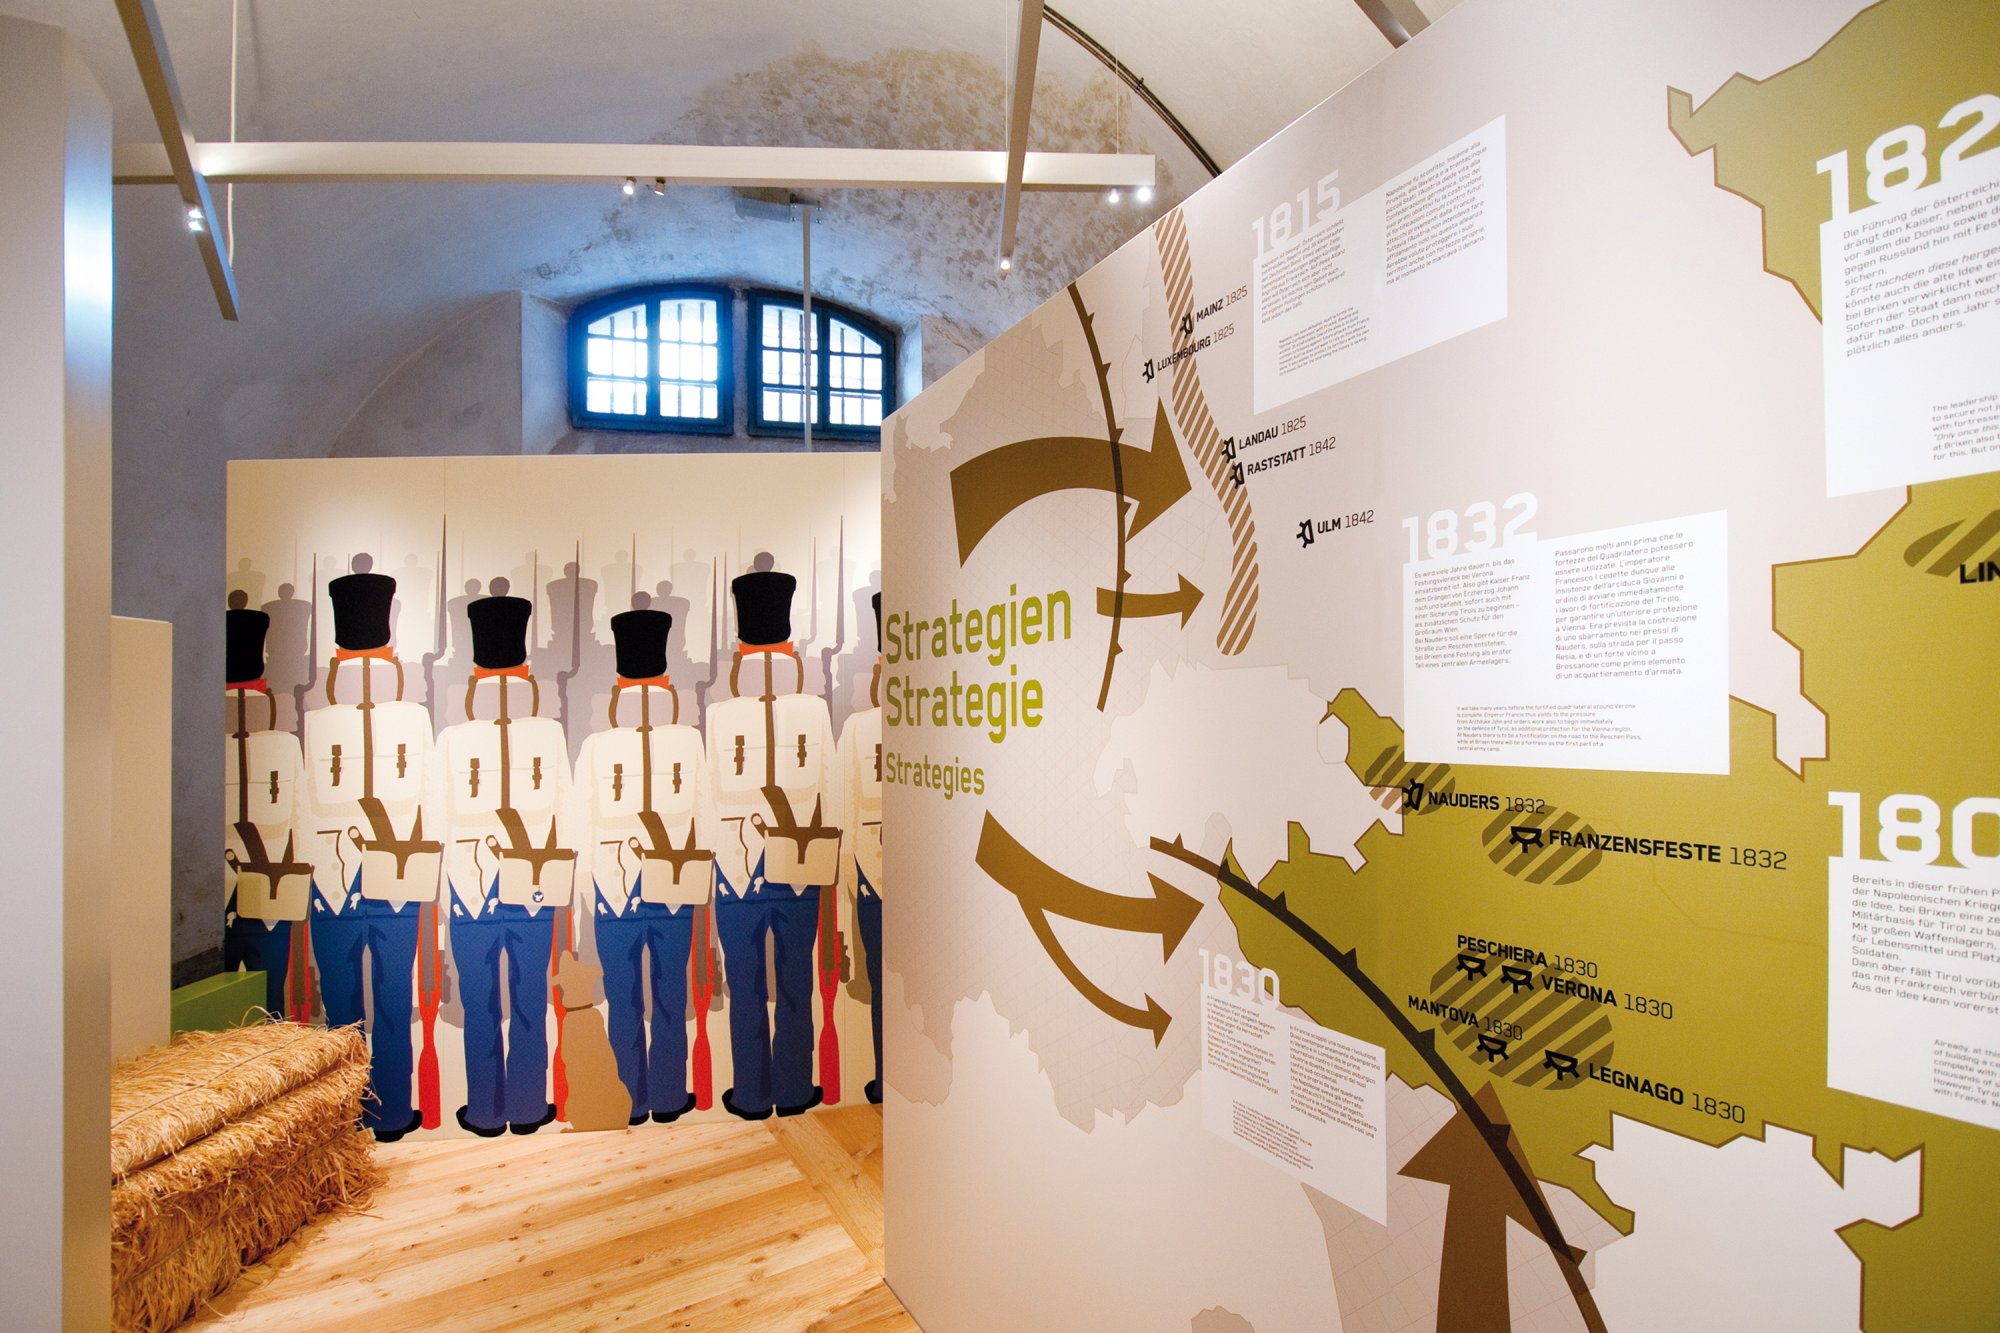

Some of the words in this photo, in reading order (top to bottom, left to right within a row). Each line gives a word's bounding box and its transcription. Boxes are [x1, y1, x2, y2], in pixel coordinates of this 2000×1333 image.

[1816, 93, 2000, 222] 182
[1252, 169, 1340, 259] 1815
[1843, 228, 1859, 240] Die
[1862, 212, 1907, 233] Führung
[1910, 204, 1930, 216] der
[1843, 232, 1879, 251] drängt
[1882, 226, 1902, 238] den
[1905, 213, 1943, 230] Kaiser,
[1946, 199, 1982, 217] neben
[1843, 251, 1862, 263] vor
[1863, 241, 1892, 256] allem
[1894, 236, 1911, 246] die
[1913, 223, 1950, 240] Donau
[1952, 210, 1988, 228] sowie
[1844, 259, 1876, 276] gegen
[1879, 240, 1930, 263] Russland
[1932, 235, 1950, 246] hin
[1952, 227, 1971, 240] mit
[1844, 268, 1887, 286] sichern.
[1845, 293, 1881, 309] könnte
[1883, 284, 1910, 298] auch
[1912, 279, 1930, 290] die
[1932, 272, 1955, 284] alte
[1957, 264, 1983, 277] Idee
[1875, 268, 1925, 289] nachdem
[1927, 258, 1959, 273] diese
[1197, 299, 1224, 323] MAINZ
[1226, 285, 1248, 307] 1825
[1845, 309, 1861, 321] bei
[1863, 300, 1899, 316] Brixen
[1901, 278, 1970, 305] verwirklicht
[1845, 317, 1883, 333] Sofern
[1885, 311, 1904, 322] der
[1907, 300, 1939, 316] Staat
[1942, 293, 1971, 307] dann
[1846, 331, 1875, 344] dafür
[1878, 323, 1907, 336] habe.
[1910, 313, 1939, 328] Doch
[1942, 308, 1960, 319] ein
[1963, 300, 1990, 313] Jahr
[1846, 338, 1890, 357] plötzlich
[1893, 332, 1919, 344] alles
[1921, 320, 1965, 337] anders.
[1157, 337, 1211, 371] LUXEMBOURG
[1213, 324, 1234, 343] 1825
[1239, 426, 1278, 450] LANDAU
[1282, 416, 1306, 435] 1825
[1247, 446, 1306, 476] RASTSTATT
[1309, 437, 1336, 456] 1842
[1318, 517, 1341, 534] ULM
[1345, 510, 1374, 529] 1842
[1402, 492, 1538, 563] 1832
[1554, 546, 1594, 557] Passarono
[1595, 542, 1614, 551] molti
[1615, 539, 1632, 548] anni
[1633, 536, 1657, 546] prima
[1658, 533, 1674, 542] che
[1555, 557, 1586, 566] fortezze
[1586, 554, 1598, 562] del
[1599, 548, 1648, 560] Quadrilatero
[1650, 541, 1693, 554] potessero
[1554, 567, 1580, 576] essere
[1581, 562, 1617, 572] utilizzate.
[1555, 575, 1593, 585] Francesco
[1598, 570, 1629, 580] cedette
[1630, 566, 1659, 576] dunque
[1661, 564, 1675, 572] alle
[1555, 585, 1592, 594] insistenze
[1642, 573, 1677, 585] Giovanni
[1558, 605, 1579, 613] lavori
[1588, 599, 1640, 610] fortificazione
[1641, 596, 1654, 605] del
[1655, 594, 1681, 603] Tirolo,
[1587, 592, 1616, 601] avviare
[1617, 584, 1684, 597] immediatamente
[886, 584, 1071, 666] Strategien
[1555, 616, 1568, 624] per
[1569, 612, 1604, 623] garantire
[1652, 604, 1698, 615] protezione
[886, 664, 1043, 743] Strategie
[886, 752, 984, 800] Strategies
[1428, 791, 1499, 810] NAUDERS
[1505, 797, 1545, 814] 1832
[1549, 830, 1721, 863] FRANZENSFESTE
[1729, 846, 1787, 870] 1832
[1851, 886, 1870, 896] der
[1873, 888, 1961, 906] Napoleonischen
[1852, 874, 1892, 886] Bereits
[1895, 878, 1905, 888] in
[1907, 880, 1944, 892] dieser
[1947, 884, 1988, 896] frühen
[1851, 898, 1868, 908] die
[1870, 900, 1895, 912] Idee,
[1898, 903, 1915, 914] bei
[1918, 905, 1956, 918] Brixen
[1959, 911, 1984, 922] eine
[1852, 910, 1915, 926] Militärbasis
[1918, 918, 1936, 928] für
[1939, 920, 1966, 932] Tirol
[1969, 926, 1983, 935] zu
[1851, 945, 1902, 961] Soldaten.
[1852, 921, 1868, 932] Mit
[1870, 926, 1911, 938] großen
[1913, 930, 1996, 951] Waffenlagern,
[1852, 933, 1868, 943] für
[1871, 936, 1944, 954] Lebensmittel
[1946, 949, 1968, 958] und
[1458, 934, 1547, 967] PESCHIERA
[1554, 955, 1598, 979] 1830
[1851, 957, 1879, 969] Dann
[1881, 963, 1907, 973] aber
[1910, 966, 1931, 978] fällt
[1935, 970, 1962, 983] Tirol
[1199, 948, 1280, 1009] 1830
[1851, 969, 1871, 980] das
[1873, 974, 1891, 984] mit
[1894, 976, 1956, 995] Frankreich
[1851, 981, 1872, 992] Aus
[1874, 985, 1893, 995] der
[1896, 988, 1920, 1000] Idee
[1922, 993, 1950, 1006] kann
[1542, 975, 1617, 1006] VERONA
[1624, 993, 1673, 1020] 1830
[1408, 995, 1479, 1028] MANTOVA
[1484, 1016, 1523, 1041] 1830
[1589, 1063, 1684, 1106] LEGNAGO
[1692, 1092, 1745, 1124] 1830
